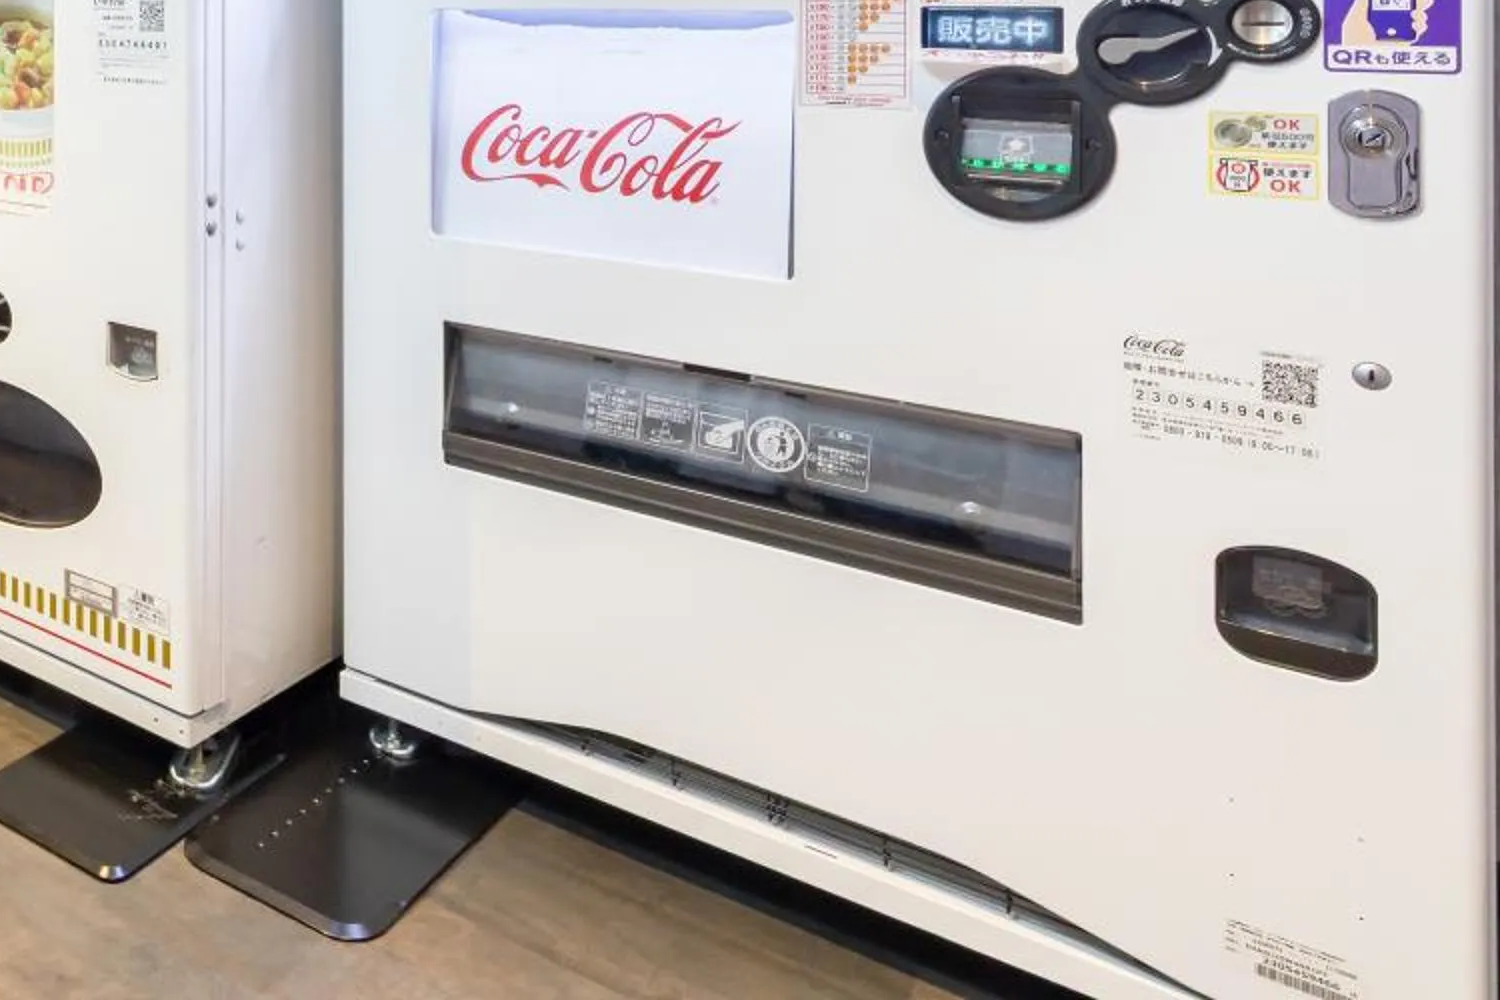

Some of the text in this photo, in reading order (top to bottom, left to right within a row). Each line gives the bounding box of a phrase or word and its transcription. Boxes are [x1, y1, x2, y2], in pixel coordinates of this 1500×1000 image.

[937, 15, 1049, 47] 販売中
[1332, 49, 1451, 66] QRも使える
[1273, 119, 1301, 131] OK
[461, 103, 743, 205] Coca-Cola
[1269, 179, 1301, 193] OK
